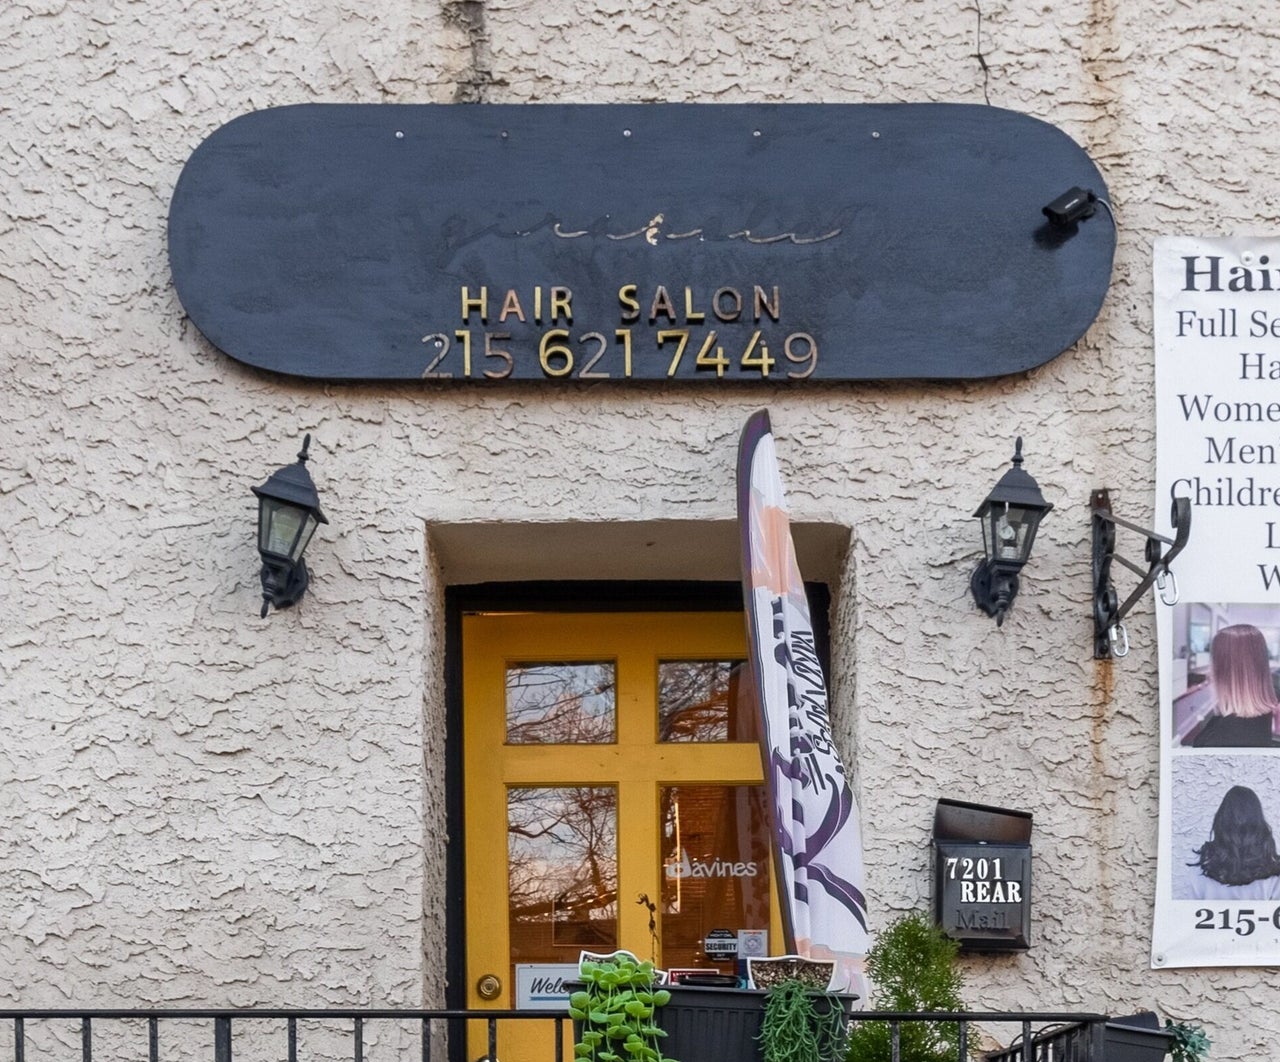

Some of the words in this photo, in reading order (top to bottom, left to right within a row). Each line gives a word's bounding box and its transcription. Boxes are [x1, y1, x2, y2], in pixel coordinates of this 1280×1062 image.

[461, 286, 574, 321] HAIR
[619, 284, 781, 321] SALON
[1176, 309, 1238, 338] Full
[422, 331, 514, 380] 215
[539, 330, 636, 379] 621
[656, 329, 818, 380] 7449
[665, 847, 757, 877] davines
[947, 858, 1002, 879] 7201
[961, 882, 1022, 902] REAR
[955, 910, 1008, 929] Mail
[706, 943, 736, 951] SECURITY
